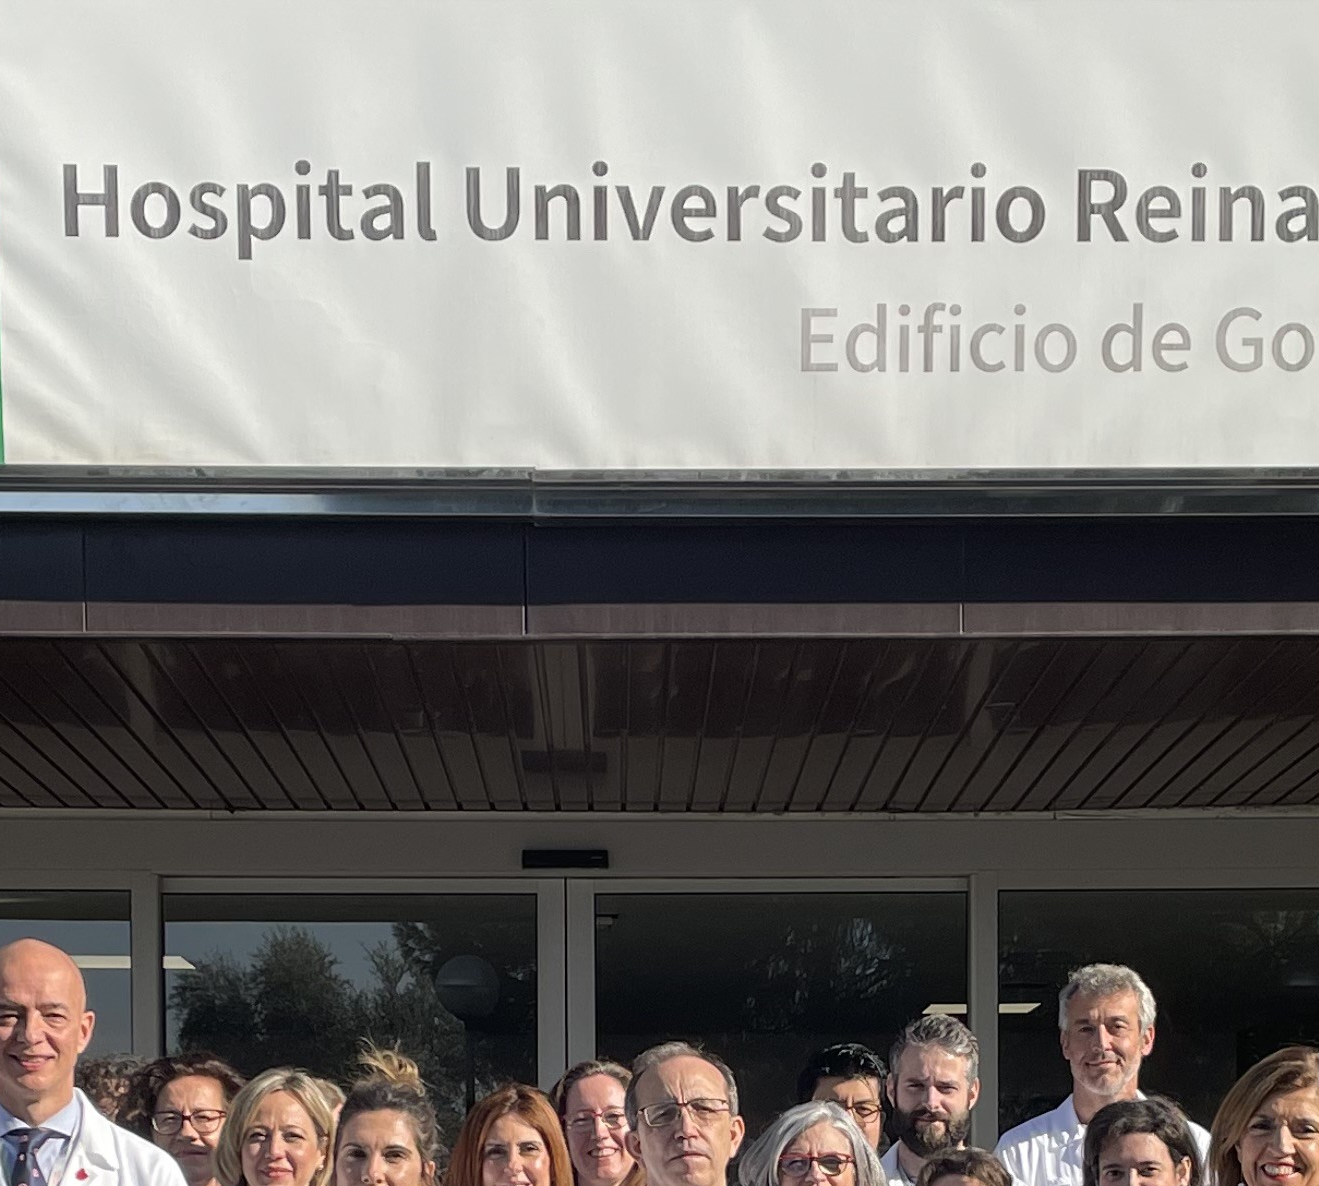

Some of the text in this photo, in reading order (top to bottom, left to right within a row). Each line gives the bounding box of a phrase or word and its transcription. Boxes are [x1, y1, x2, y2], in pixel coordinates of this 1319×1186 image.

[63, 160, 437, 260] Hospital
[466, 161, 1045, 243] Universitario
[1077, 162, 1319, 243] Reina
[800, 302, 1077, 374] Edificio
[1101, 302, 1192, 373] de
